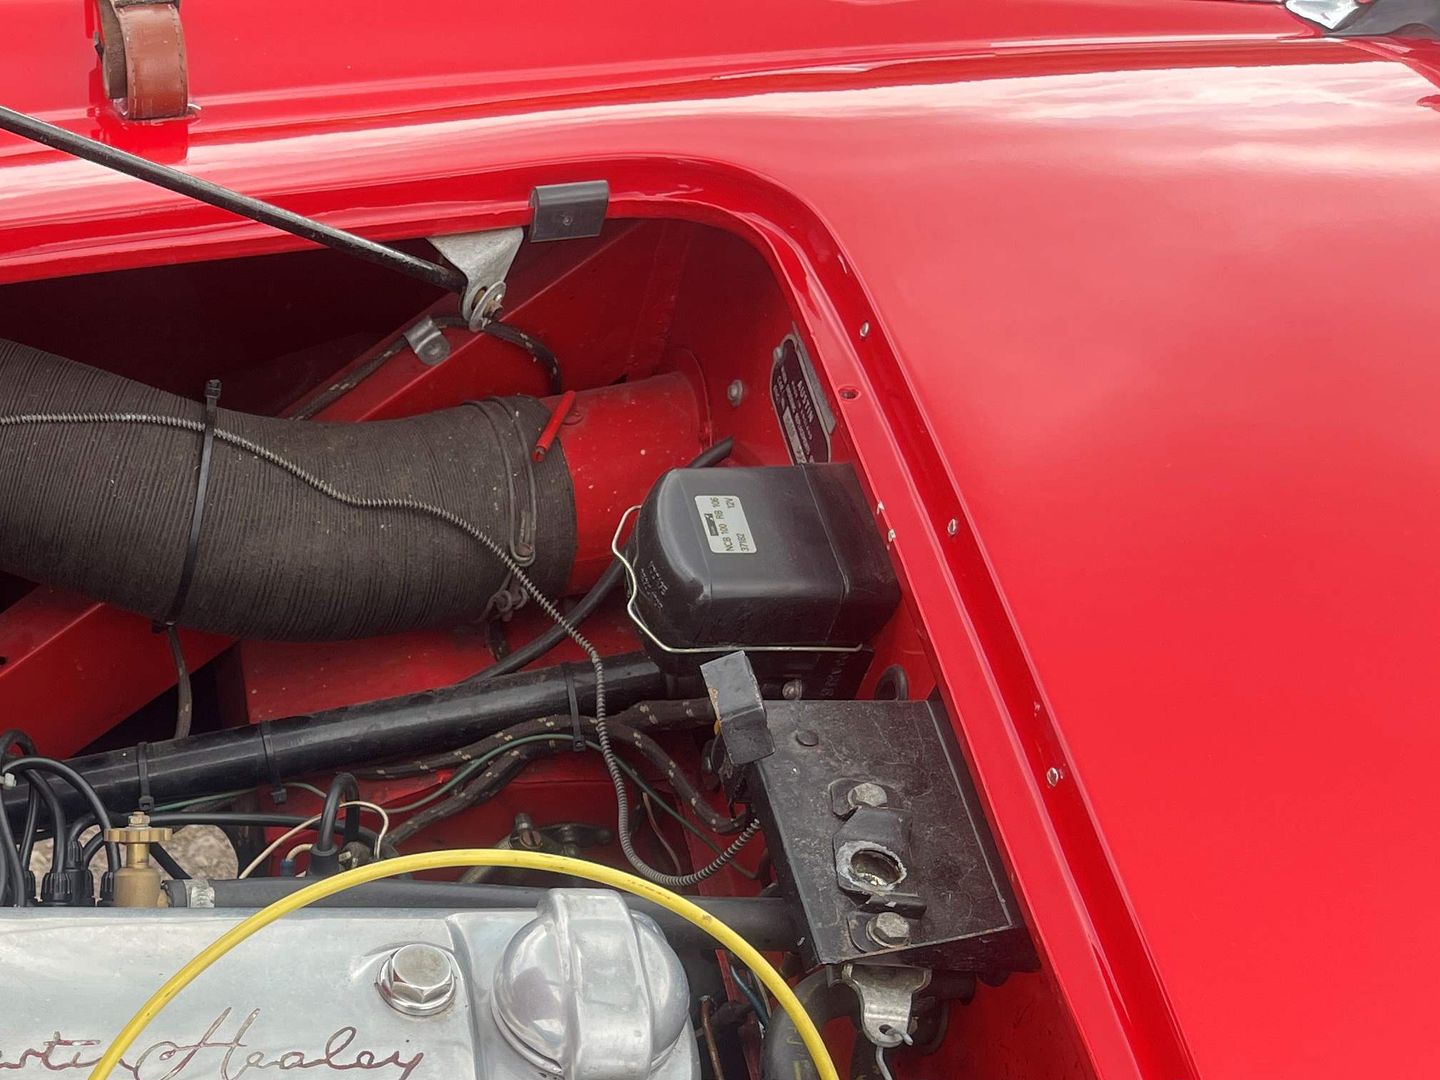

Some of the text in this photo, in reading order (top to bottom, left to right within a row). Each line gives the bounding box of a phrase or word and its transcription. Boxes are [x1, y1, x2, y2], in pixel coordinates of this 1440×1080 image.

[797, 380, 814, 423] AUSTIN
[723, 497, 736, 509] 12V
[713, 509, 725, 520] RB
[718, 523, 729, 535] 100
[722, 536, 734, 552] NCB
